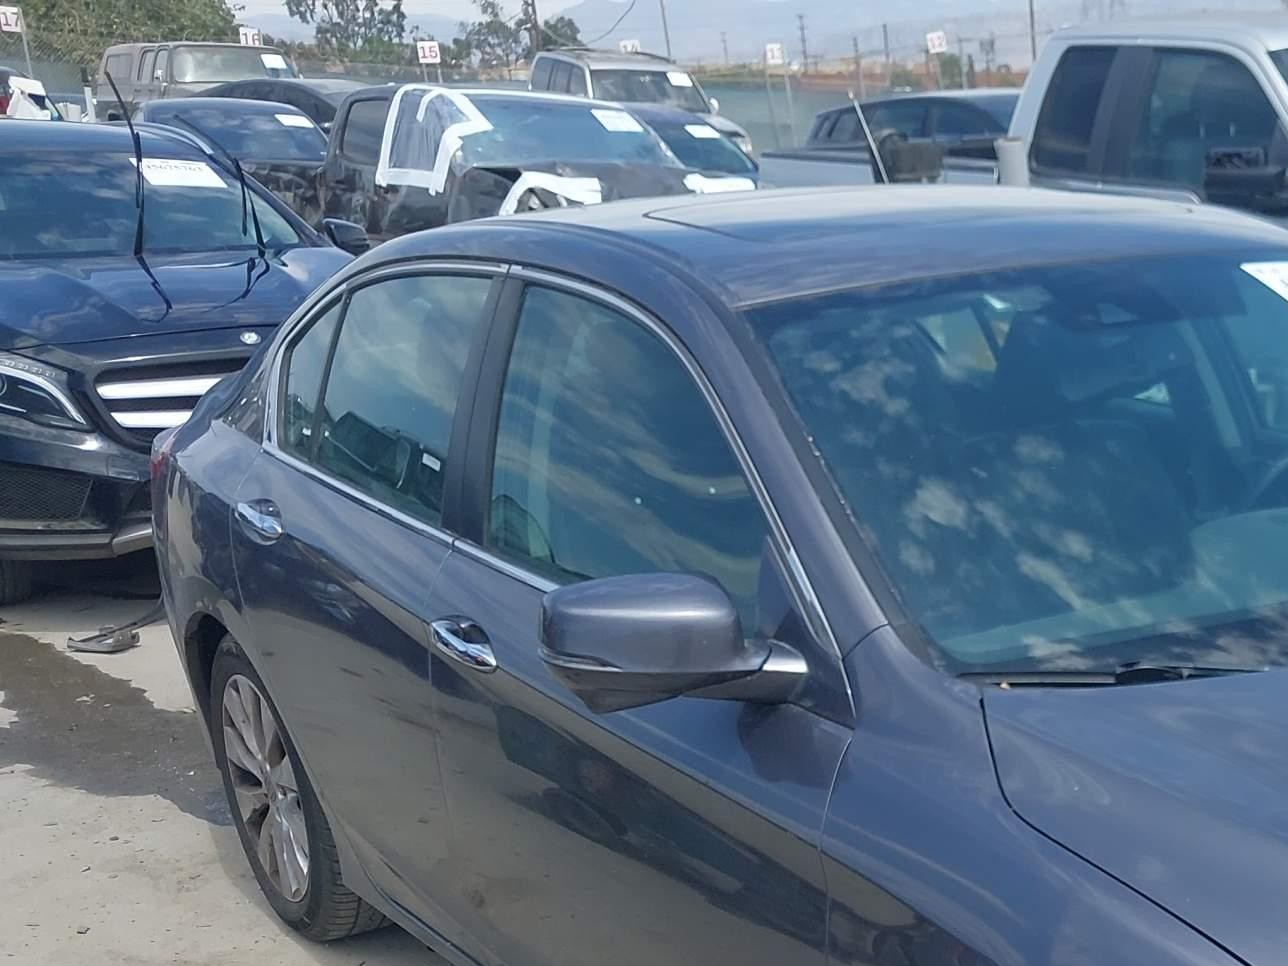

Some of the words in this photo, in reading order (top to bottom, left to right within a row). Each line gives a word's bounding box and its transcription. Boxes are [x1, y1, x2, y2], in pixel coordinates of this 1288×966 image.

[1, 11, 19, 27] 17
[241, 32, 260, 46] 16
[420, 45, 438, 59] 15
